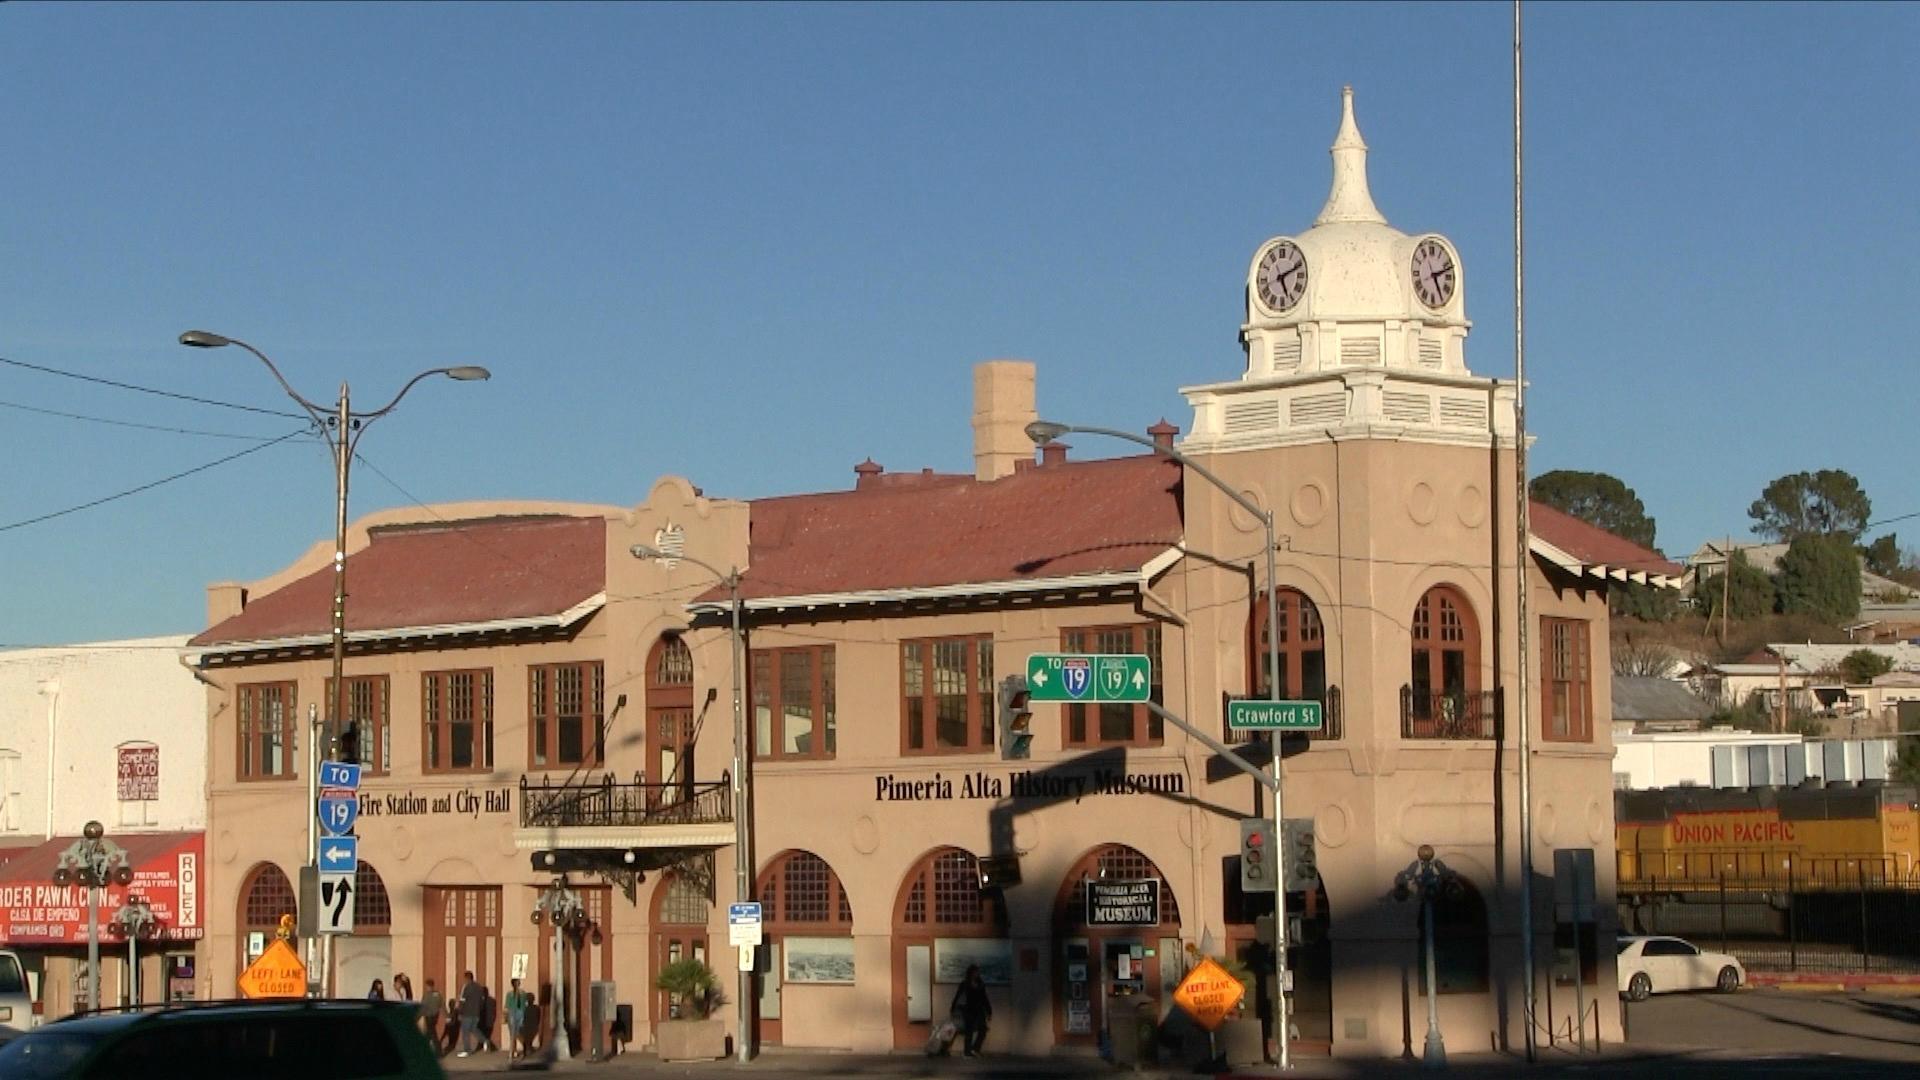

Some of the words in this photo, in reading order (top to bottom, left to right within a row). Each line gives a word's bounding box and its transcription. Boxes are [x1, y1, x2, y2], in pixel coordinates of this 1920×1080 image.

[1047, 658, 1062, 670] TO
[1068, 669, 1086, 690] 19
[1108, 672, 1123, 690] 19
[1236, 708, 1296, 724] Crawford
[1301, 708, 1315, 723] St
[331, 767, 349, 783] TO
[875, 773, 953, 801] Pimeria
[960, 771, 1002, 799] Alta
[1009, 771, 1087, 805] History
[1093, 768, 1184, 796] Museum
[357, 792, 383, 817] Fire
[386, 789, 428, 816] Station
[432, 796, 452, 813] and
[456, 789, 482, 819] City
[485, 788, 511, 813] Hall
[331, 803, 349, 826] 19
[1673, 822, 1724, 844] UNION
[1733, 820, 1795, 842] PACIFIC
[36, 886, 71, 907] PAWN
[182, 856, 194, 923] ROLEX
[10, 908, 31, 922] CASA
[33, 908, 44, 922] DE
[1095, 905, 1152, 922] MUSEUM
[252, 968, 274, 979] LEFT
[281, 968, 302, 980] LANE
[258, 982, 295, 993] CLOSED
